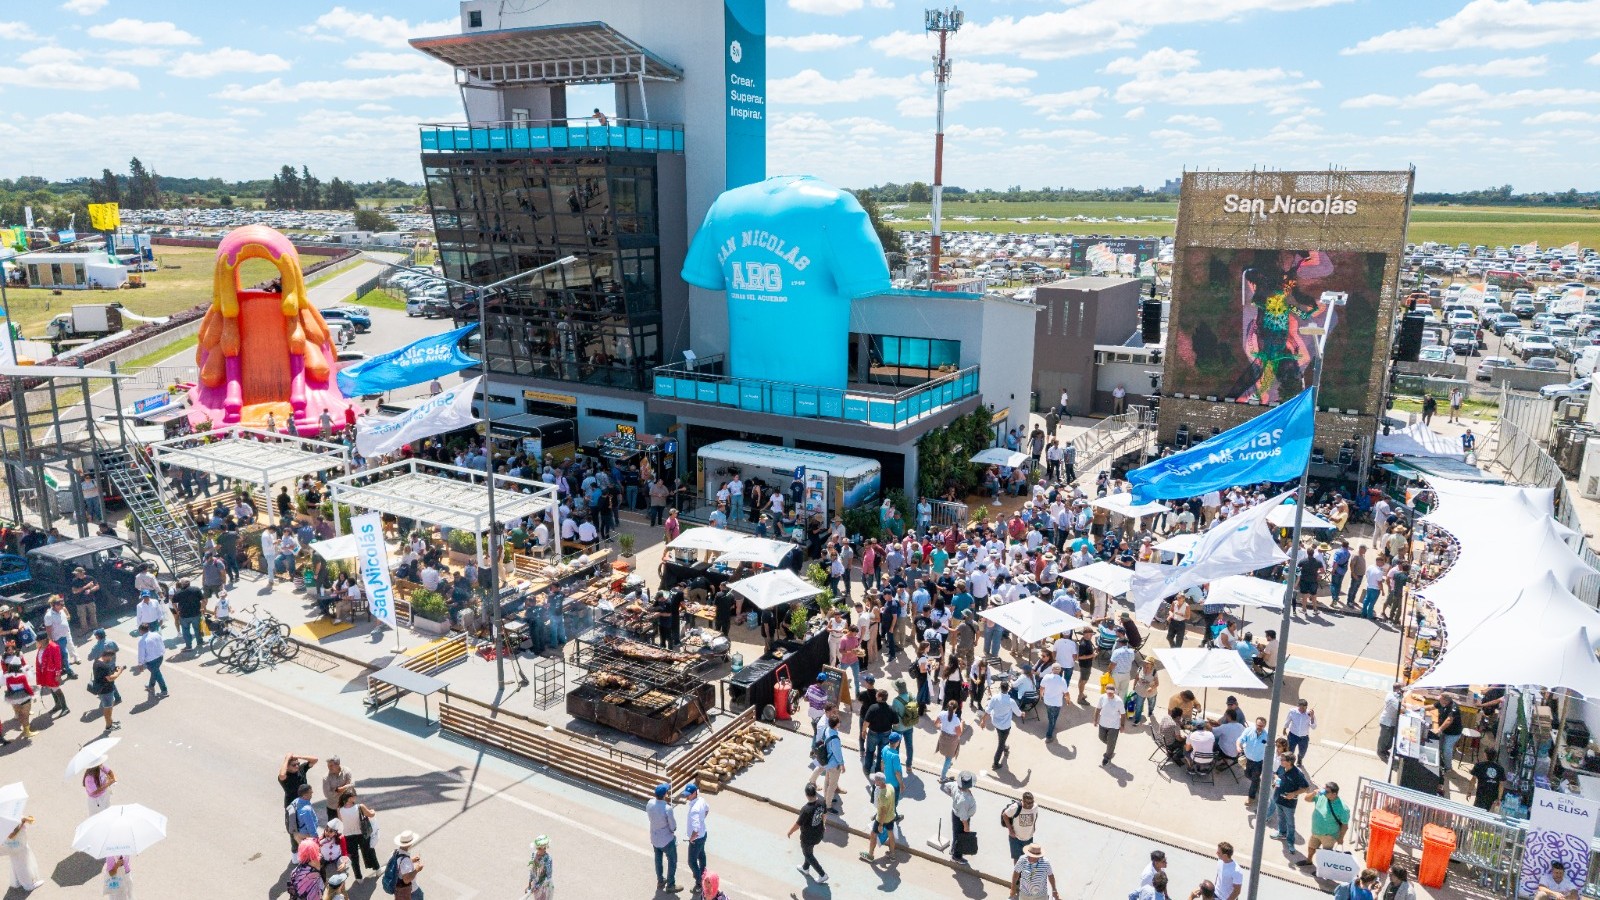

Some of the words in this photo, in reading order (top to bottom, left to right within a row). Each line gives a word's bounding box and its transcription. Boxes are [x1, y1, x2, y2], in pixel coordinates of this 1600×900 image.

[730, 74, 756, 88] Crear.
[730, 90, 764, 104] Superar.
[730, 106, 763, 120] Inspirar.
[1223, 194, 1267, 219] San
[1269, 194, 1358, 215] Nicolás
[741, 229, 811, 271] NICOLAS
[732, 261, 783, 292] ARG
[757, 294, 788, 303] ACUERDO
[359, 524, 383, 586] Nicolás
[373, 585, 388, 619] San
[1540, 799, 1554, 810] LA
[1557, 804, 1589, 818] ELISA
[1323, 861, 1353, 872] IVECO
